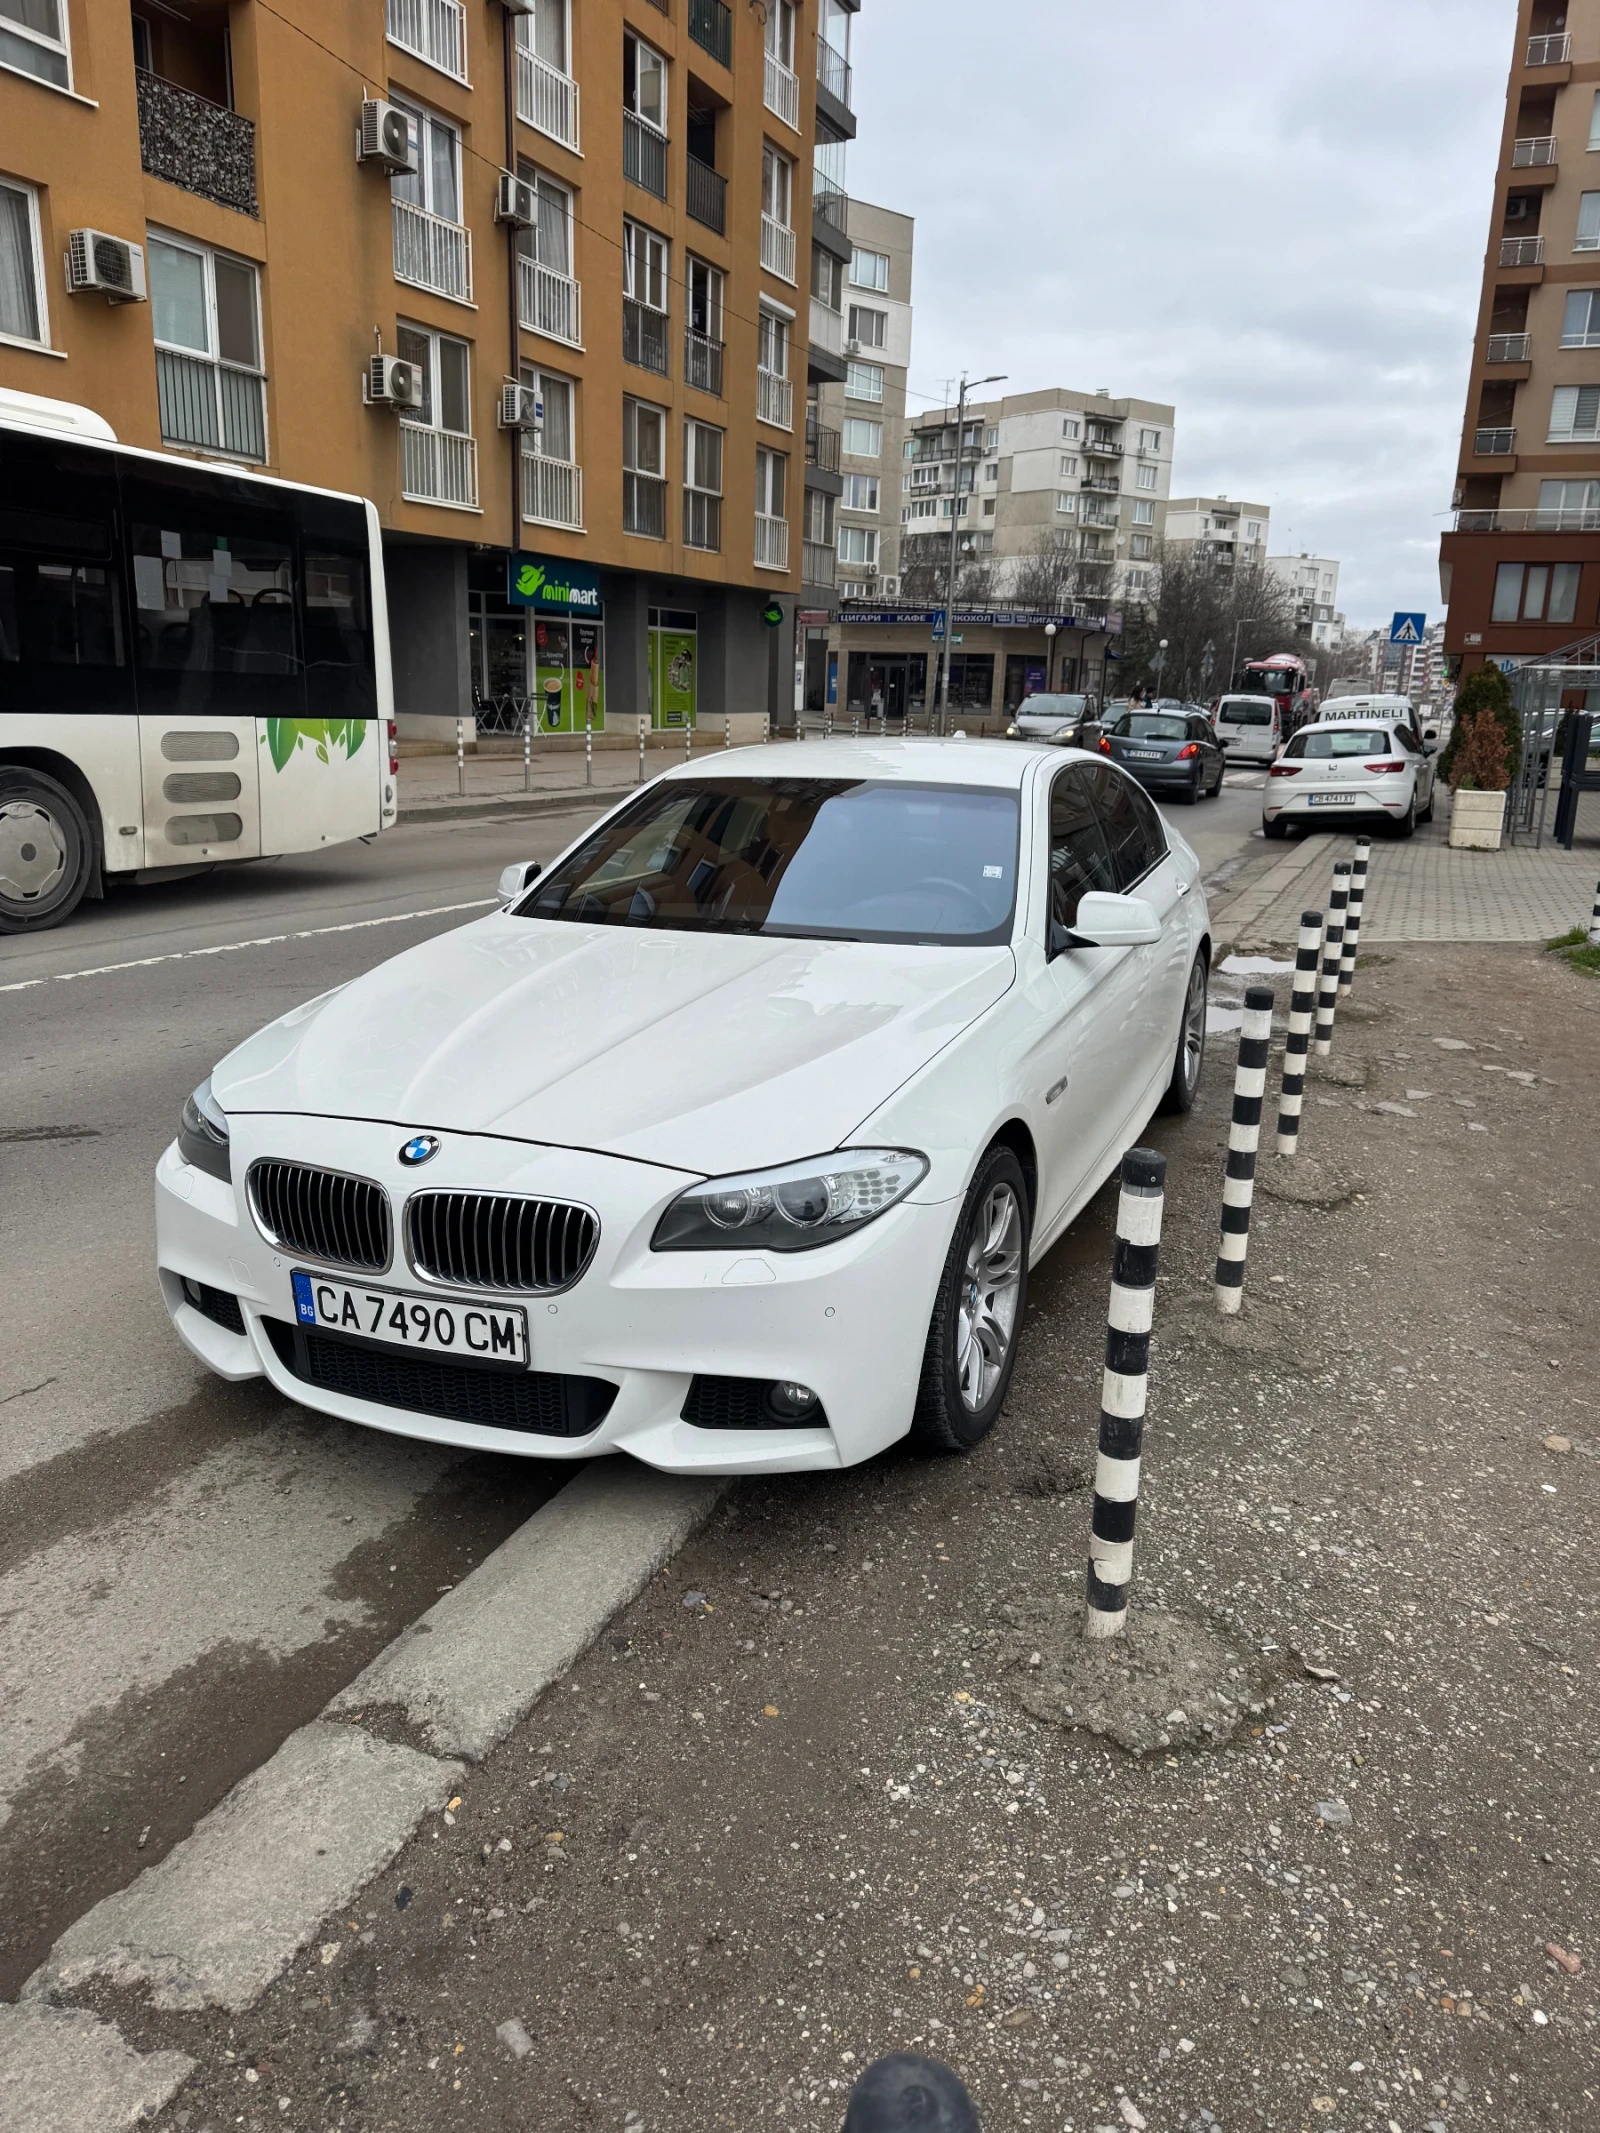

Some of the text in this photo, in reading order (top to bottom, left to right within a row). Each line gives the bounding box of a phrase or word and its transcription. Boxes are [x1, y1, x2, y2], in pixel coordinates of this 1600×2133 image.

[542, 580, 598, 606] minimart
[840, 614, 882, 623] ЦИГАРИ
[896, 615, 927, 623] КАФЕ
[951, 614, 991, 623] ЛКОХОЛ
[1029, 616, 1064, 626] ЦИГАРИ
[1325, 709, 1403, 721] MARTINELI
[1325, 794, 1342, 804] 4741
[1343, 794, 1354, 803] XT
[300, 1303, 314, 1317] BG
[316, 1285, 517, 1355] CA 7490 CM
